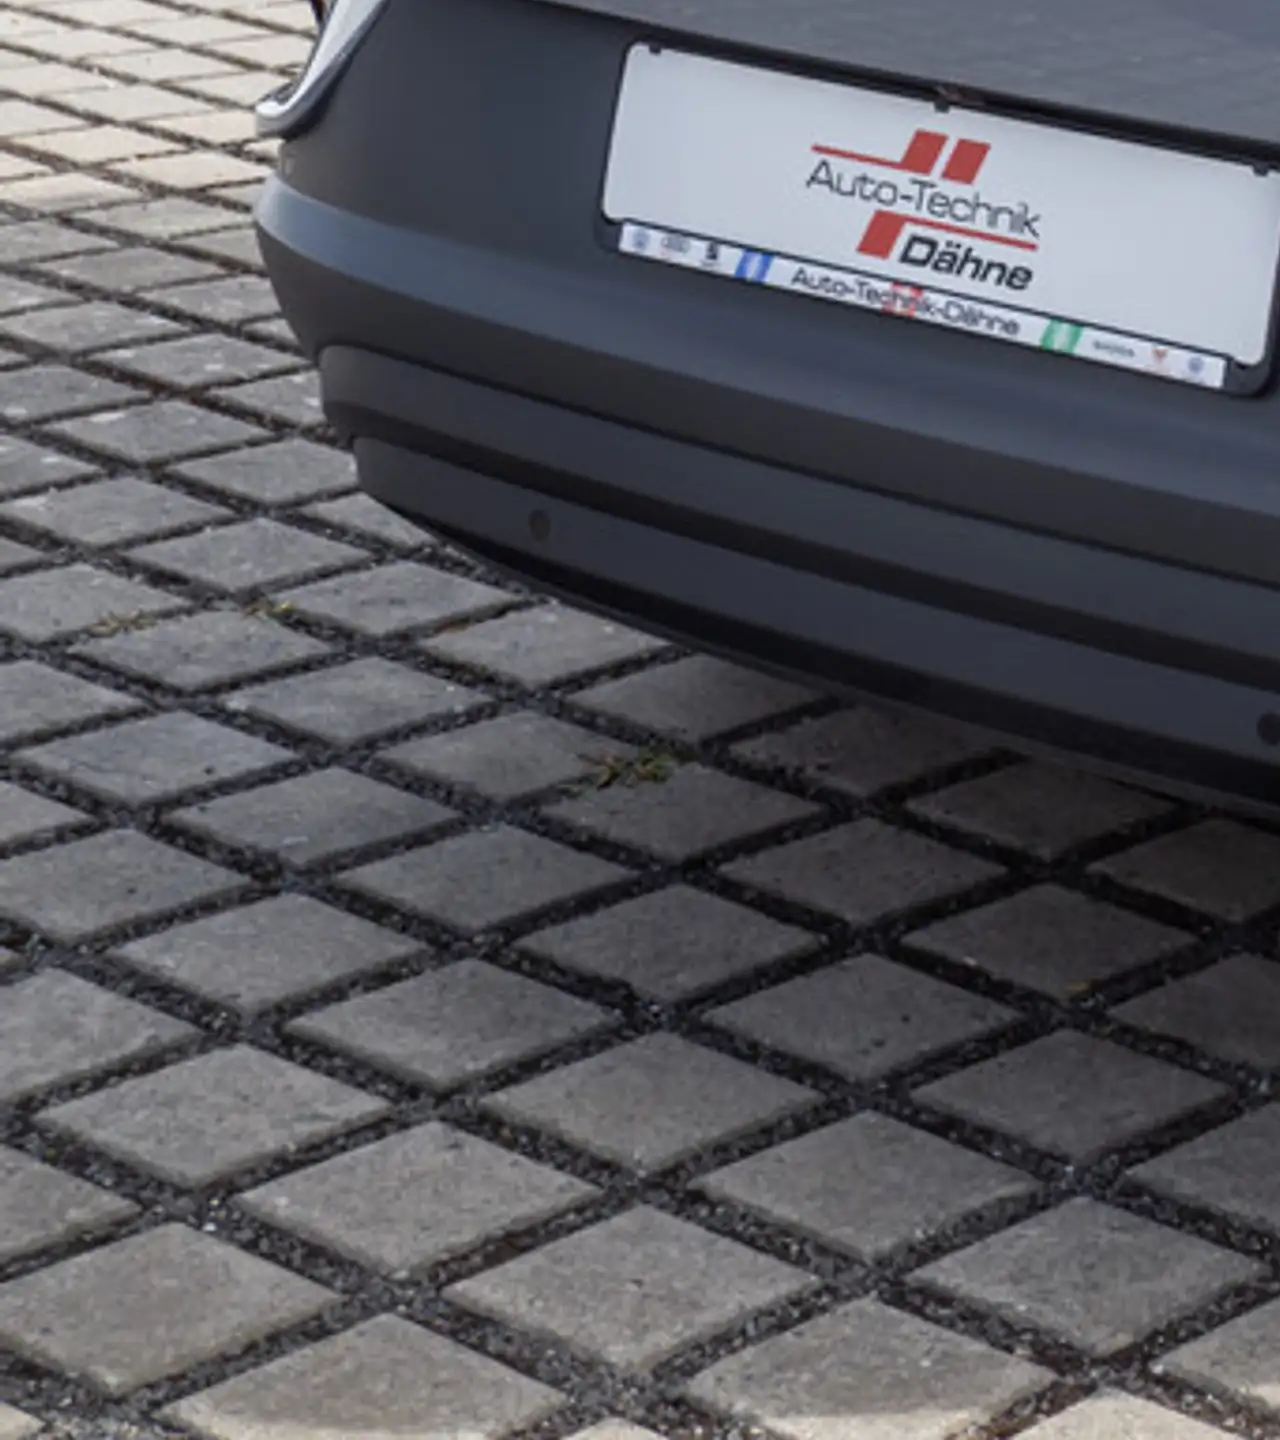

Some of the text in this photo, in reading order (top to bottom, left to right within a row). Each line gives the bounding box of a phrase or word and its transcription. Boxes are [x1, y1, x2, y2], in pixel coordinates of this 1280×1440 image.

[806, 159, 1041, 239] Auto-Technik
[899, 233, 1034, 291] Dähne
[791, 265, 1021, 336] Auto-Technik-Dähne
